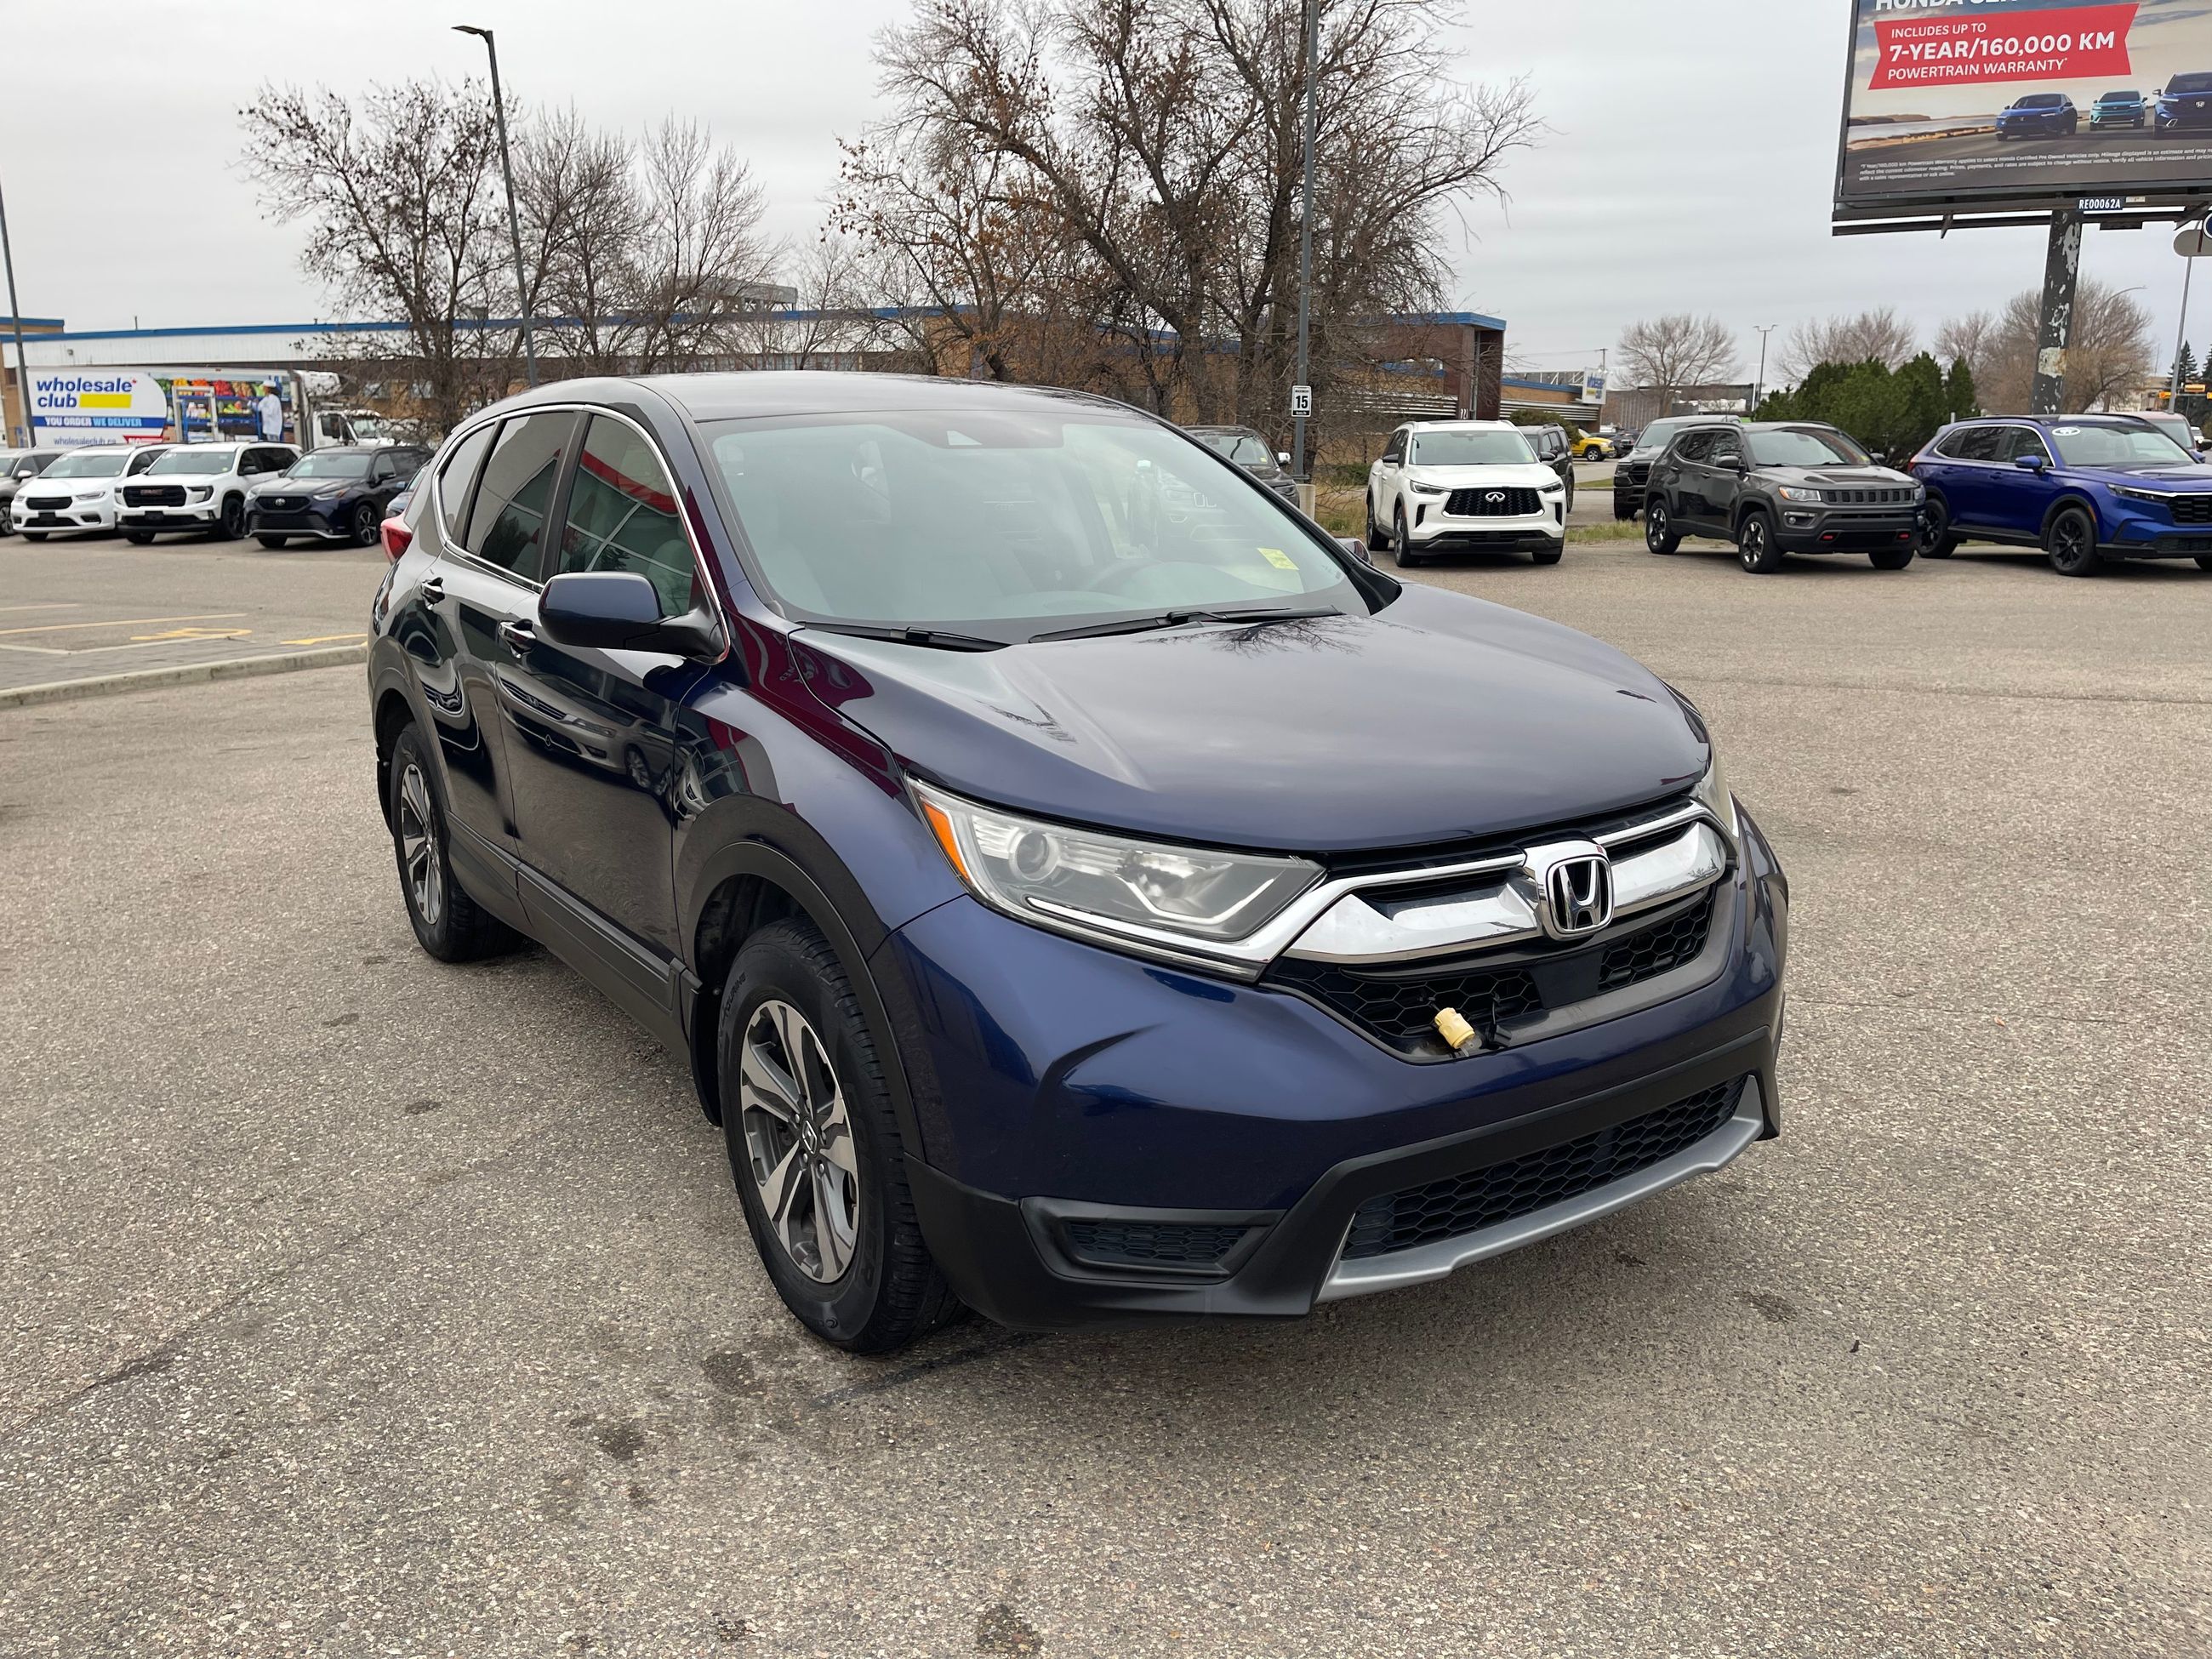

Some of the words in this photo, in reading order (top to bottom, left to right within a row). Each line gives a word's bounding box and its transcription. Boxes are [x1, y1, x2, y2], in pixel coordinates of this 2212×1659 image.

[1891, 25, 1949, 38] INCLUDES
[1952, 23, 1968, 35] UP
[1970, 22, 1987, 33] TO
[1889, 33, 2071, 63] 7-YEAR/160,000
[2078, 31, 2115, 49] KM
[1888, 63, 1979, 80] POWERTRAIN
[2078, 198, 2121, 209] RE00062A
[37, 377, 132, 391] wholesale
[37, 393, 77, 408] club
[1295, 395, 1308, 408] 15
[44, 417, 62, 426] YOU
[64, 417, 91, 426] ORDER
[93, 417, 106, 426] WE
[107, 418, 142, 427] DELIVER
